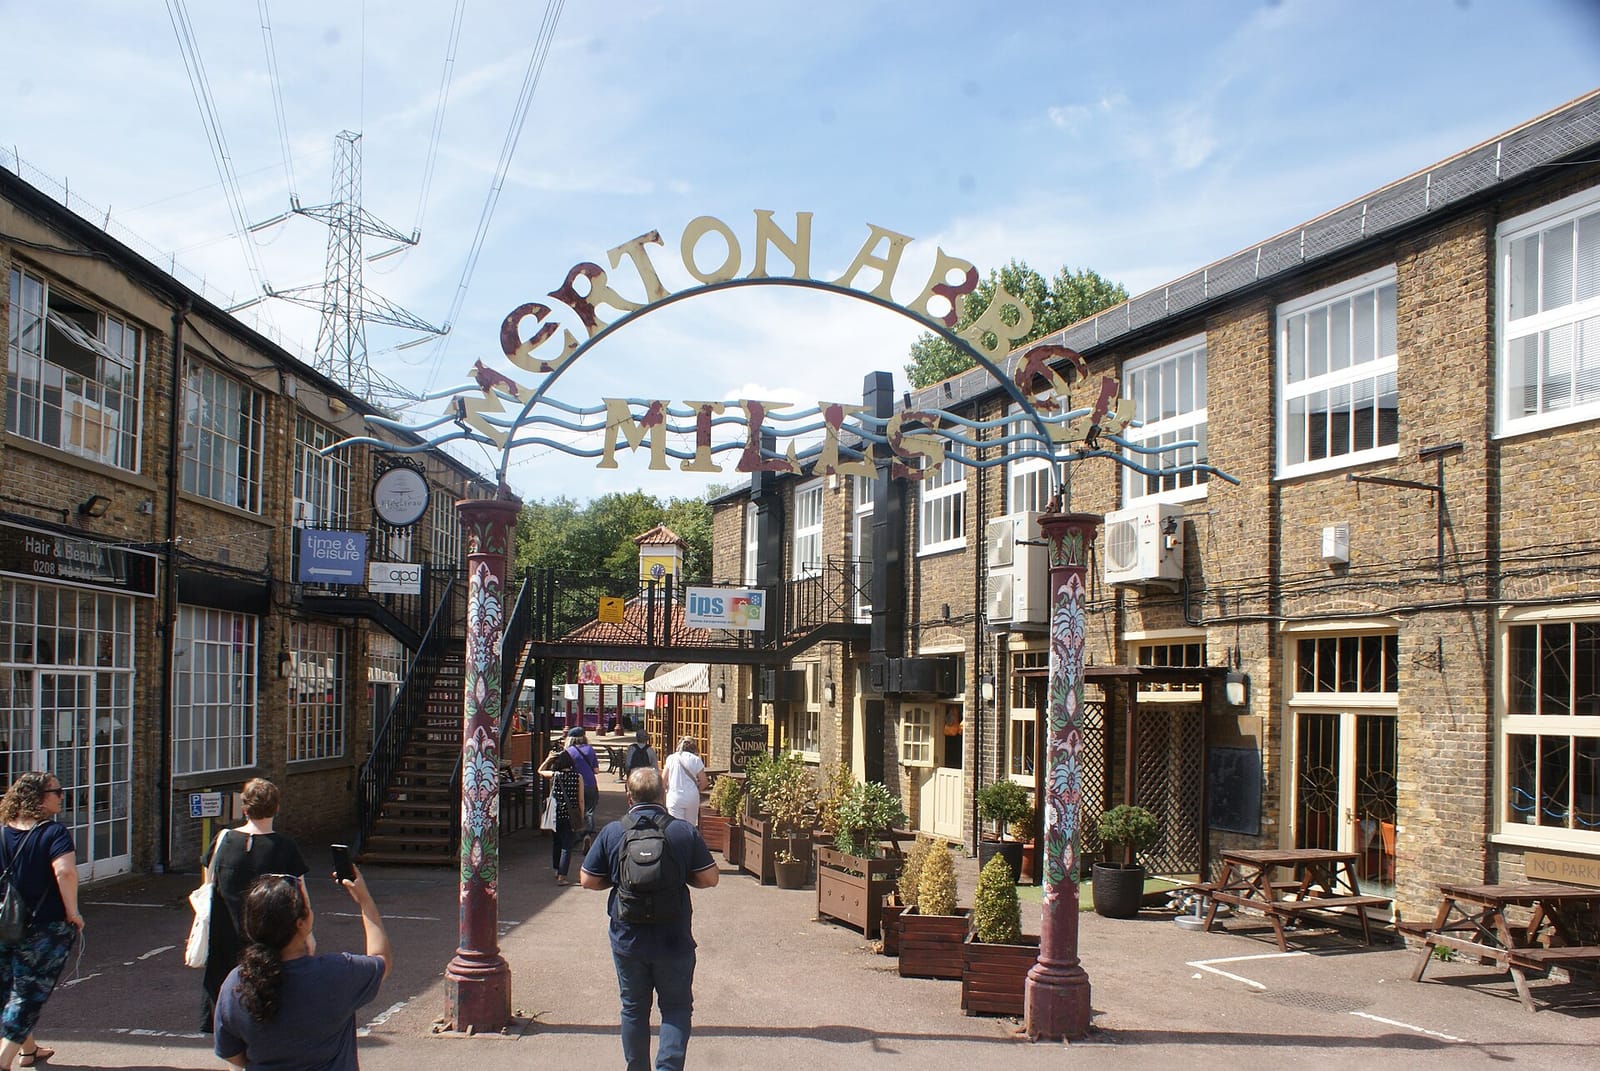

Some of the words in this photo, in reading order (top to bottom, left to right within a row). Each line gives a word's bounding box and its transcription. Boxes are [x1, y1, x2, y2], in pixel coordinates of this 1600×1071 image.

[596, 397, 945, 481] MILLS
[25, 535, 50, 555] Hair
[53, 543, 62, 558] &
[65, 544, 103, 568] Beauty
[308, 536, 341, 551] time
[346, 538, 356, 551] &
[313, 547, 360, 560] leisure
[33, 559, 55, 575] 0208
[690, 592, 724, 616] ips
[732, 736, 767, 754] SUNDAY
[1534, 859, 1557, 874] NO
